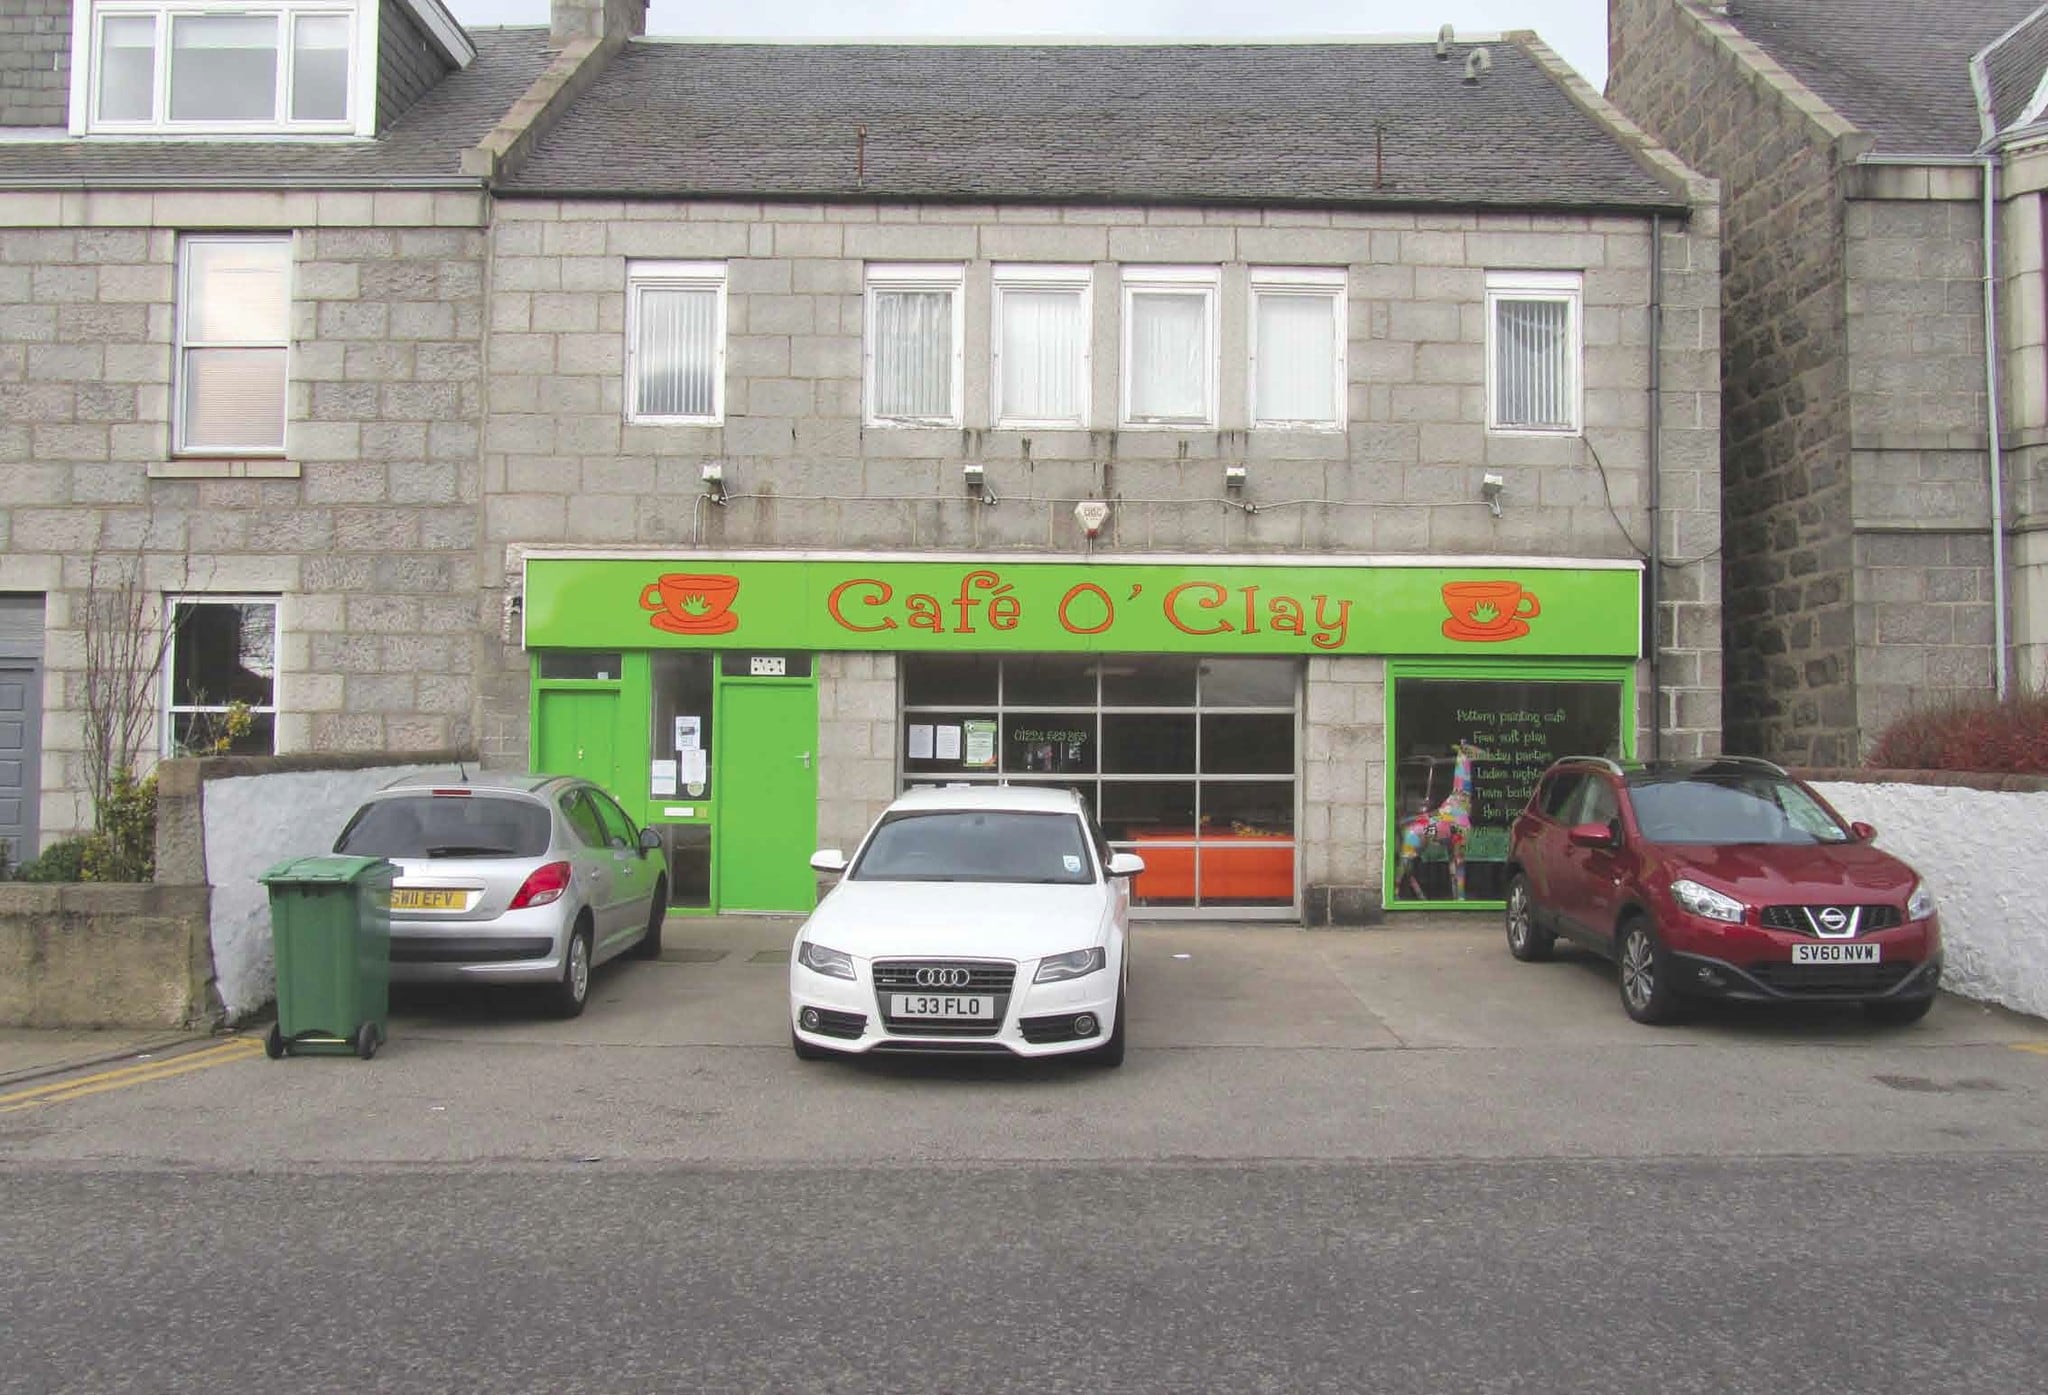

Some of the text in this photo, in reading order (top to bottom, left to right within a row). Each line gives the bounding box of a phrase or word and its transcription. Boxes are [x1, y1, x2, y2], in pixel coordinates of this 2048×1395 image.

[828, 570, 1021, 634] Café
[1457, 709, 1496, 726] Pottery
[1500, 710, 1542, 727] painting
[1473, 728, 1547, 746] Free soft play
[1515, 749, 1553, 764] parties
[1477, 766, 1508, 779] Ladies
[1474, 785, 1533, 799] Team build
[1483, 803, 1502, 819] Hen
[423, 891, 454, 907] EFV
[1800, 945, 1874, 961] SV60 NVW
[905, 997, 980, 1015] L33 FLO
